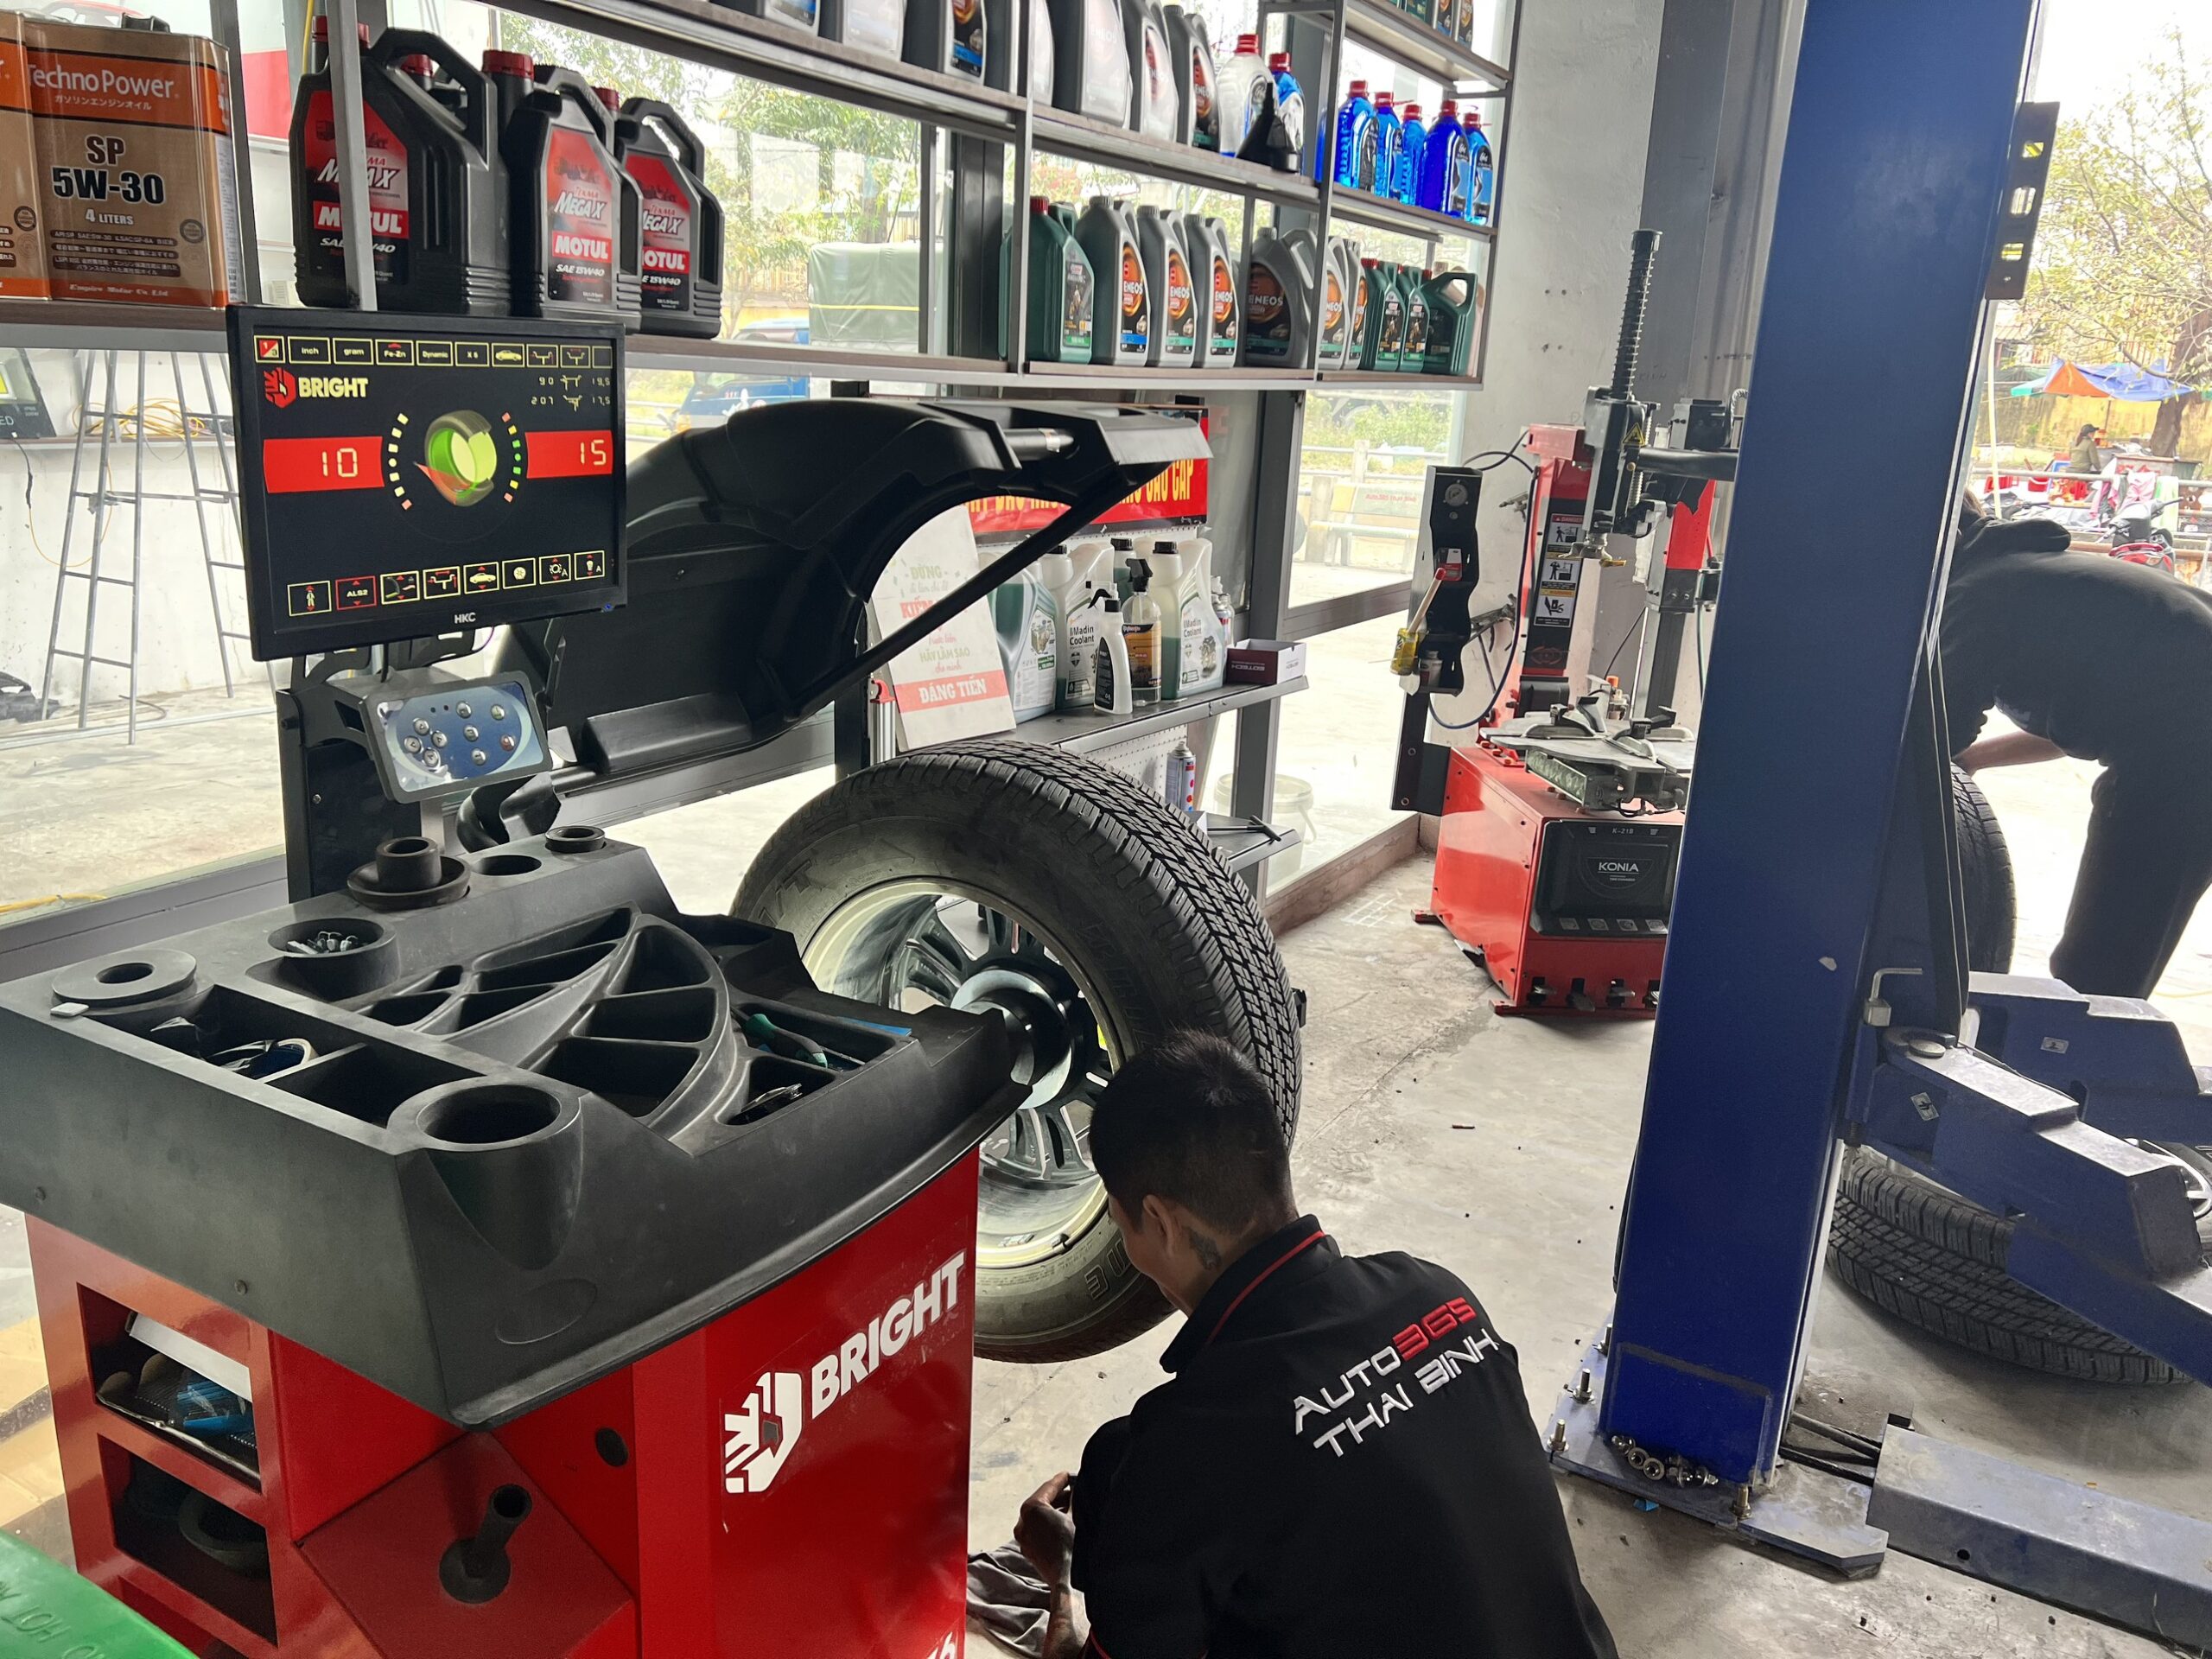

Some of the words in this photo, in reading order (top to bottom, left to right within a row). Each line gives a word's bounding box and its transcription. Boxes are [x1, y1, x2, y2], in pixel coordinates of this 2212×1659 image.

[55, 94, 152, 111] ガソリンエンジンオイル
[86, 135, 125, 167] SP
[51, 167, 164, 205] 5W-30
[554, 190, 591, 219] MEGA
[591, 200, 607, 220] X
[86, 208, 96, 222] 4
[99, 213, 134, 226] LITERS
[317, 205, 402, 234] MUL
[668, 218, 683, 234] X
[554, 234, 609, 259] MOTUL
[642, 249, 686, 270] OTUL
[556, 264, 575, 274] SAE
[575, 265, 605, 277] 15W40
[649, 275, 682, 286] 15W40
[1123, 280, 1144, 294] ENEOS
[1169, 286, 1191, 299] ENEOS
[1214, 290, 1233, 303] ENEOS
[1248, 294, 1284, 307] ENEOS
[343, 348, 365, 357] gram
[422, 350, 449, 359] Dynamic
[298, 377, 369, 398] BRIGHT
[321, 447, 359, 479] 10
[579, 439, 607, 467] 15
[346, 588, 369, 599] ALS2
[454, 612, 477, 624] HKC
[1073, 625, 1094, 635] Madin
[1069, 635, 1095, 645] Coolant
[918, 683, 957, 704] ĐÁNG
[1598, 861, 1640, 873] KONIA
[810, 1251, 966, 1420] BRIGHT
[1414, 1327, 1500, 1395] BINH
